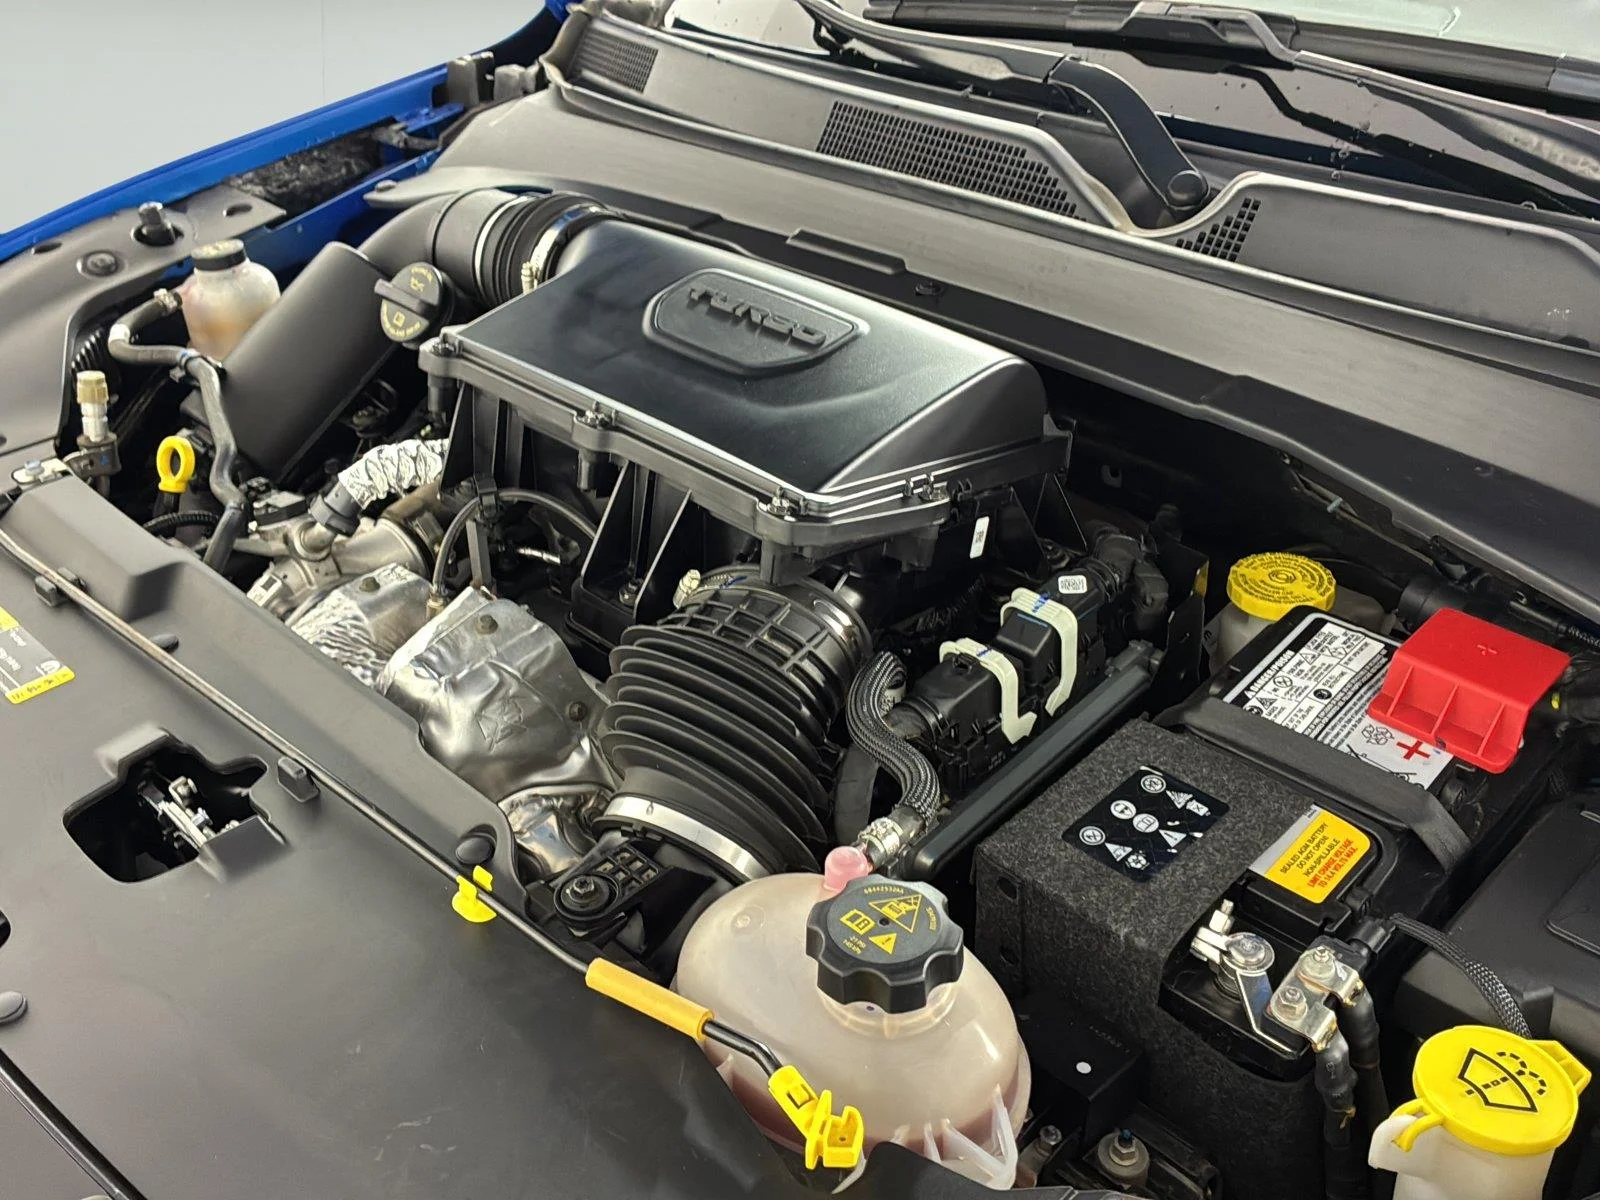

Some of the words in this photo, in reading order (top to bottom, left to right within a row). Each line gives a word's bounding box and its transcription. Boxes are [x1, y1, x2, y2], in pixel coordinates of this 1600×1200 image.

[689, 287, 827, 346] TURBO
[1279, 854, 1301, 874] SEALED
[1297, 843, 1311, 856] AGM
[1306, 822, 1329, 844] BATTERY
[1296, 859, 1306, 870] DO
[1302, 850, 1315, 862] NOT
[1303, 838, 1341, 877] NON-SPILLABLE
[1318, 858, 1337, 875] CHARGE
[1332, 838, 1354, 859] VOLTAGE
[1318, 879, 1328, 888] TO
